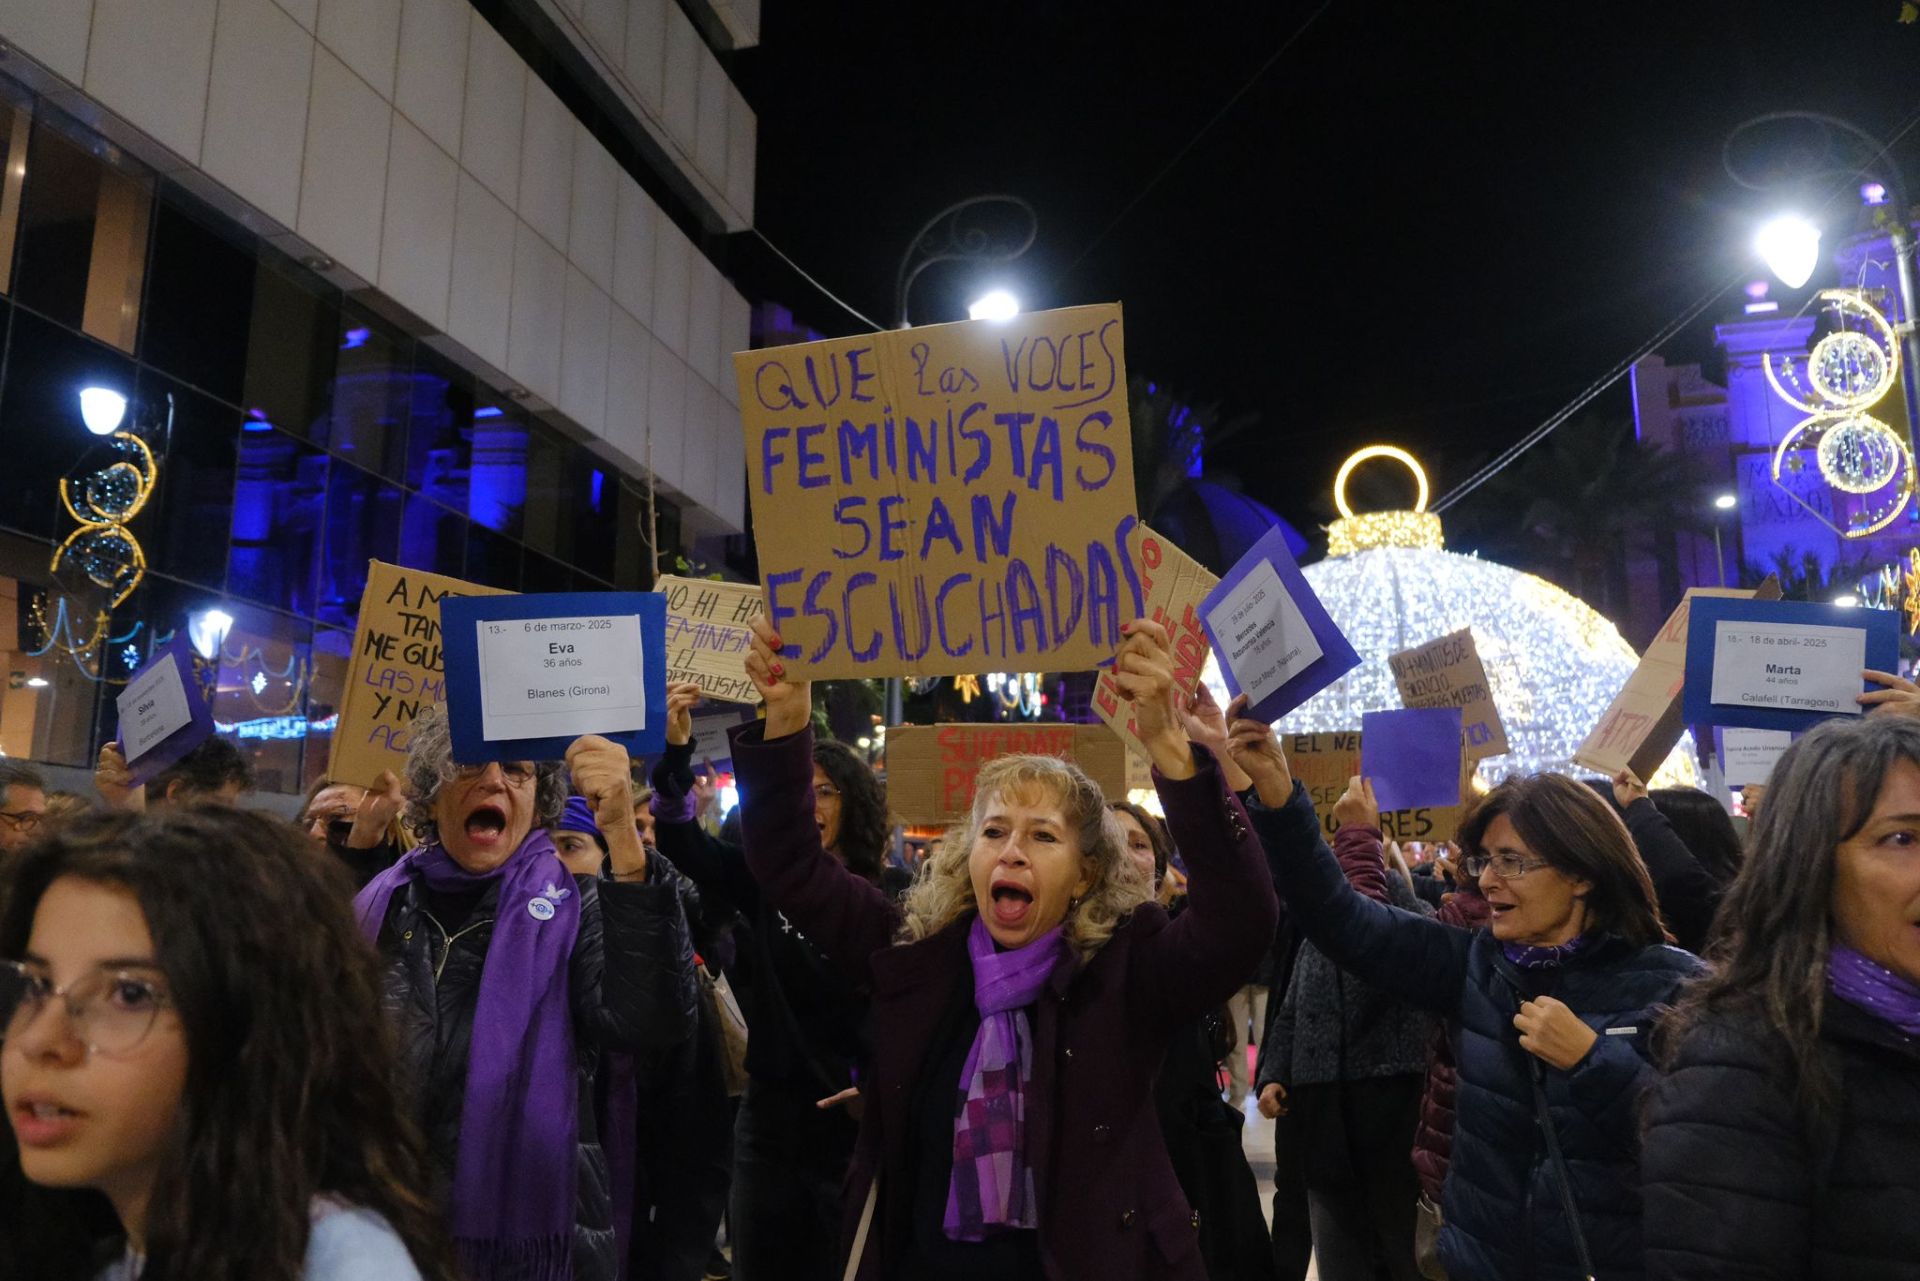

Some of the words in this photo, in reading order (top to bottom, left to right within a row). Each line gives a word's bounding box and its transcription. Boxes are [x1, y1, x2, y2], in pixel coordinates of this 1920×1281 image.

[755, 348, 877, 411] QUE
[1002, 319, 1118, 411] VOCES
[762, 401, 1117, 502] FEMINISTAS
[833, 490, 1017, 563] SEAN
[386, 577, 408, 607] A
[766, 514, 1146, 669] ESCUCHADAS
[692, 590, 719, 620] HI
[524, 623, 531, 633] 6
[534, 622, 548, 632] de
[588, 619, 612, 630] 2025
[364, 628, 399, 661] ME
[549, 643, 575, 654] Eva
[1763, 637, 1774, 646] de
[1803, 639, 1828, 648] 2025
[543, 658, 556, 668] 36
[558, 657, 583, 667] años
[673, 648, 696, 671] EL
[1765, 664, 1801, 676] Marta
[365, 663, 414, 694] LAS
[418, 677, 447, 701] MU
[527, 688, 565, 699] Blanes
[569, 684, 610, 698] (Girona)
[667, 667, 758, 700] APITALISME
[1766, 677, 1776, 685] 44
[1778, 677, 1799, 686] años
[372, 692, 392, 720] Y
[1741, 693, 1778, 704] Calafell
[1780, 695, 1840, 709] (Tarragona)
[1294, 736, 1322, 753] EL
